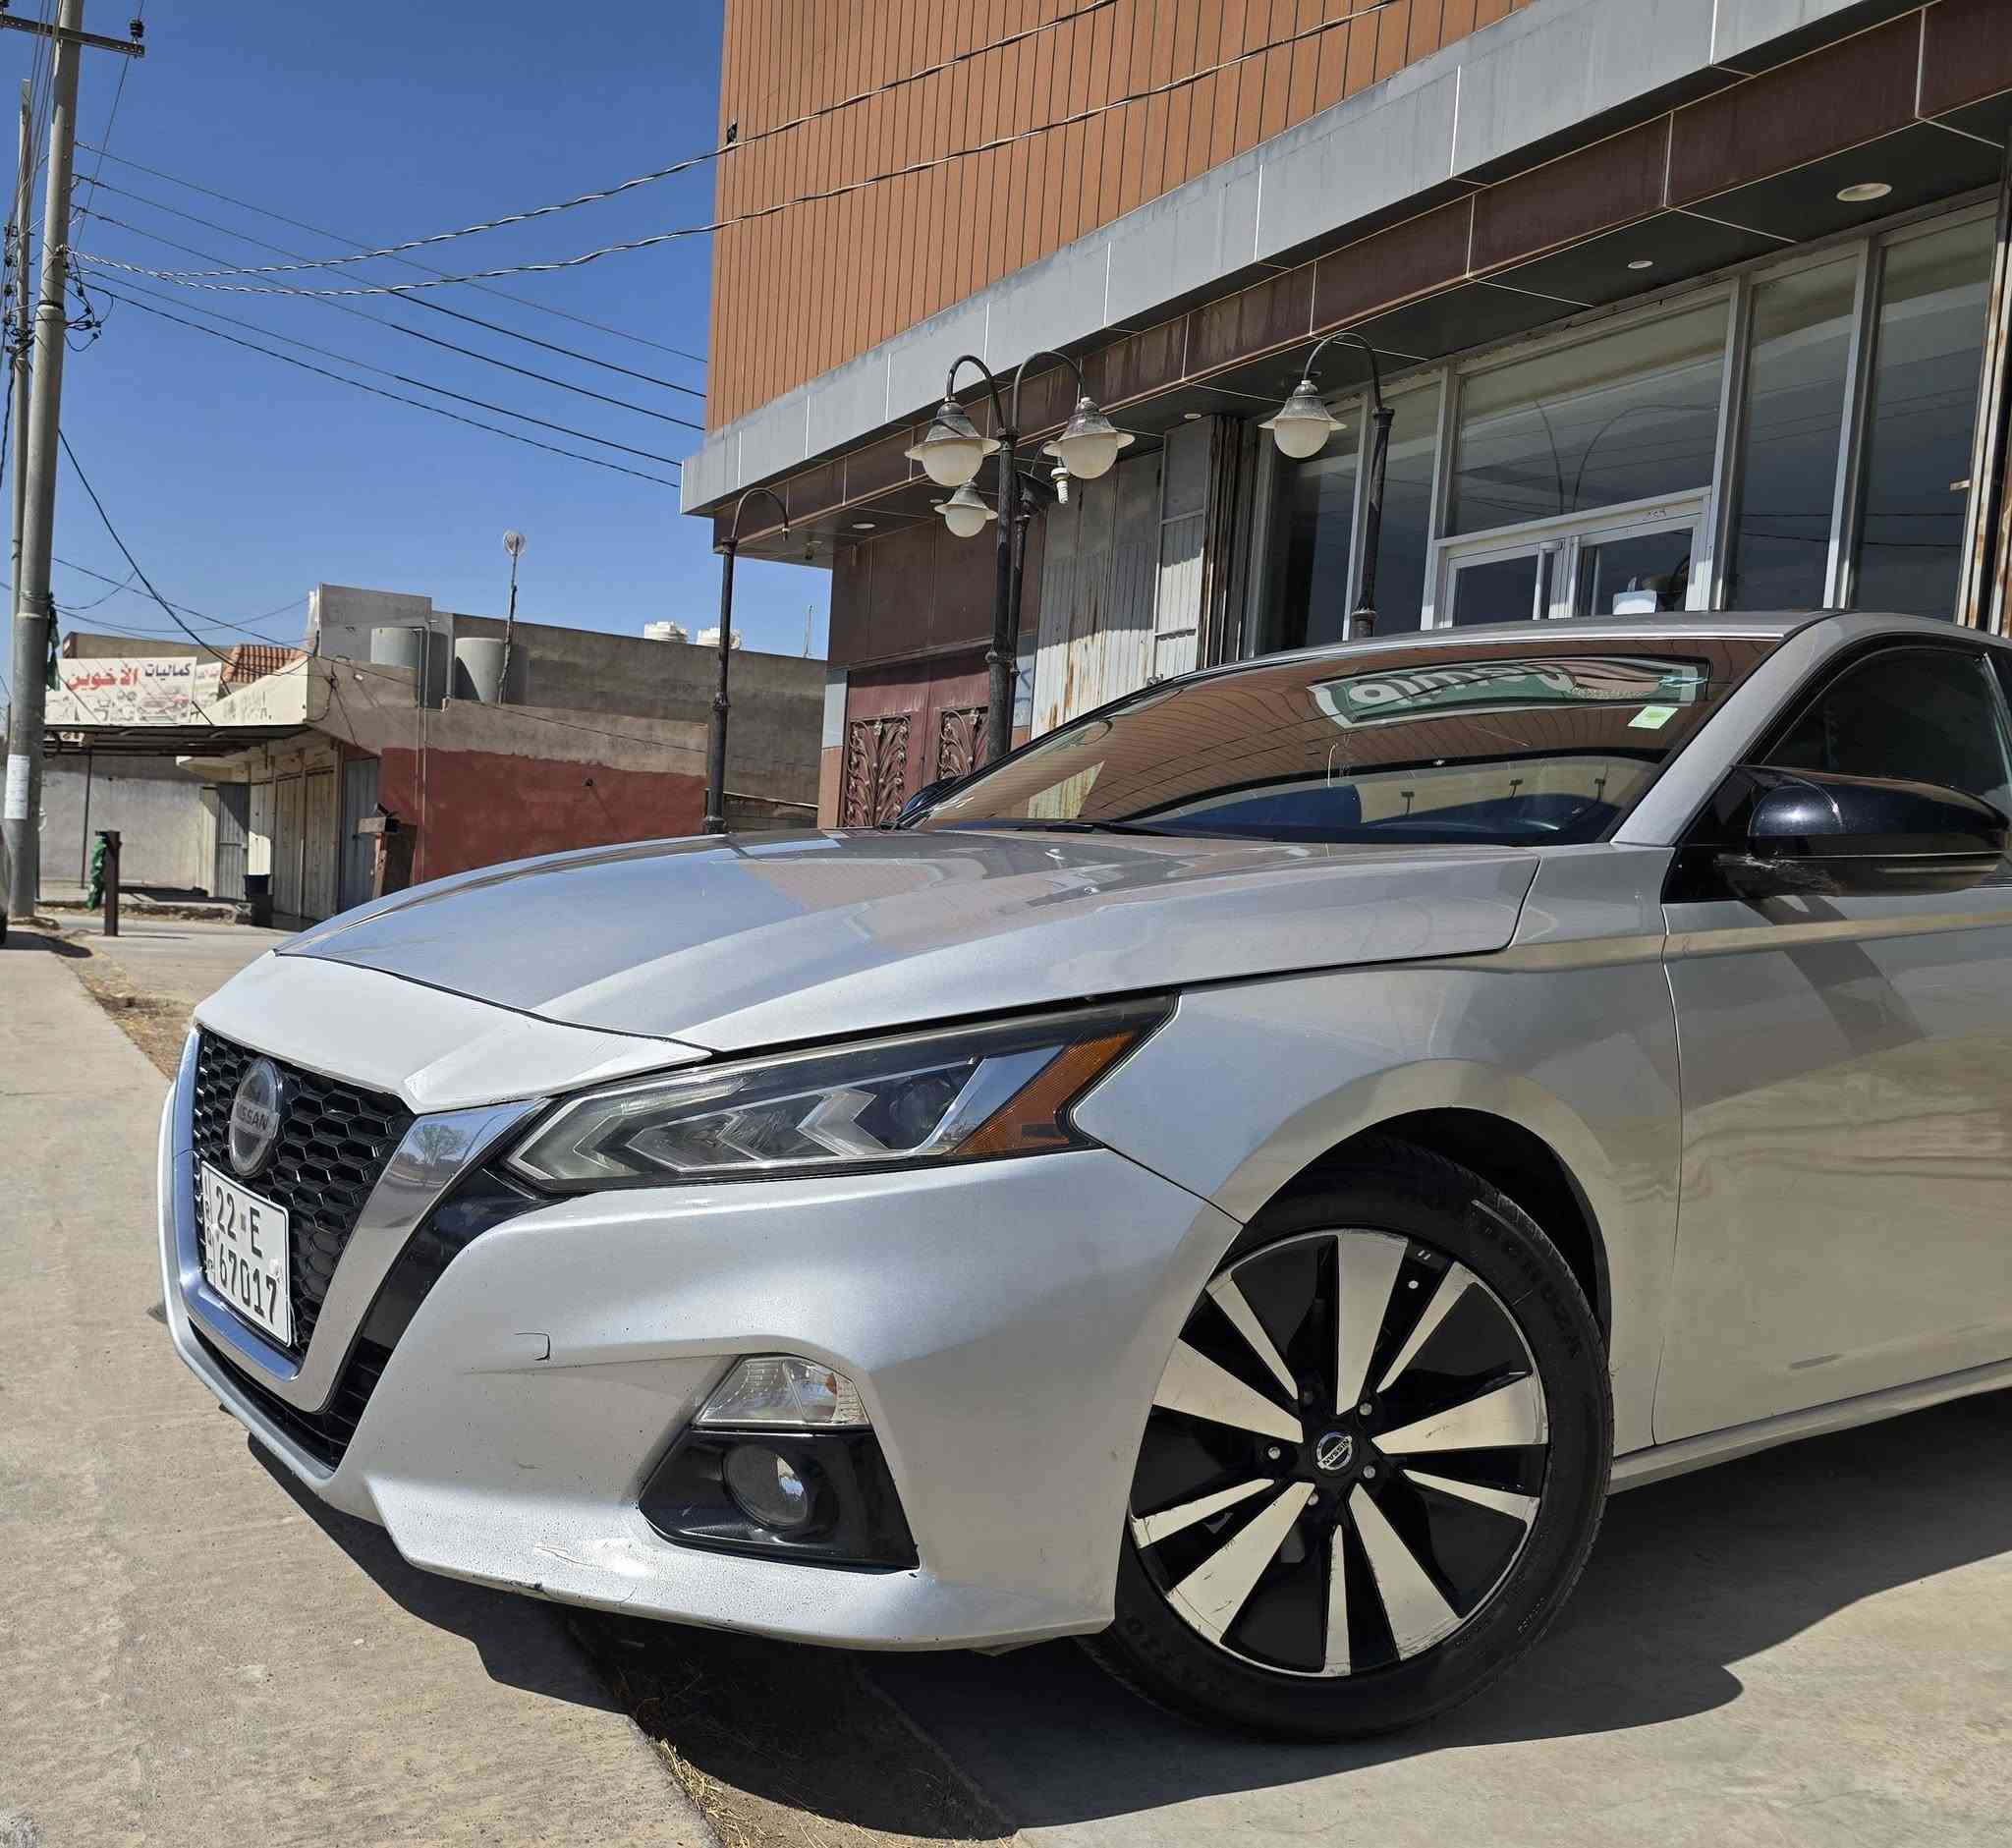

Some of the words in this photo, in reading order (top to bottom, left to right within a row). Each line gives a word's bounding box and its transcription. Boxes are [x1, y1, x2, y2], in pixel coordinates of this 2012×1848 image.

[144, 662, 192, 681] كماليات
[249, 1205, 263, 1259] E
[219, 1243, 277, 1325] 67017
[1321, 1438, 1350, 1464] NISSAN
